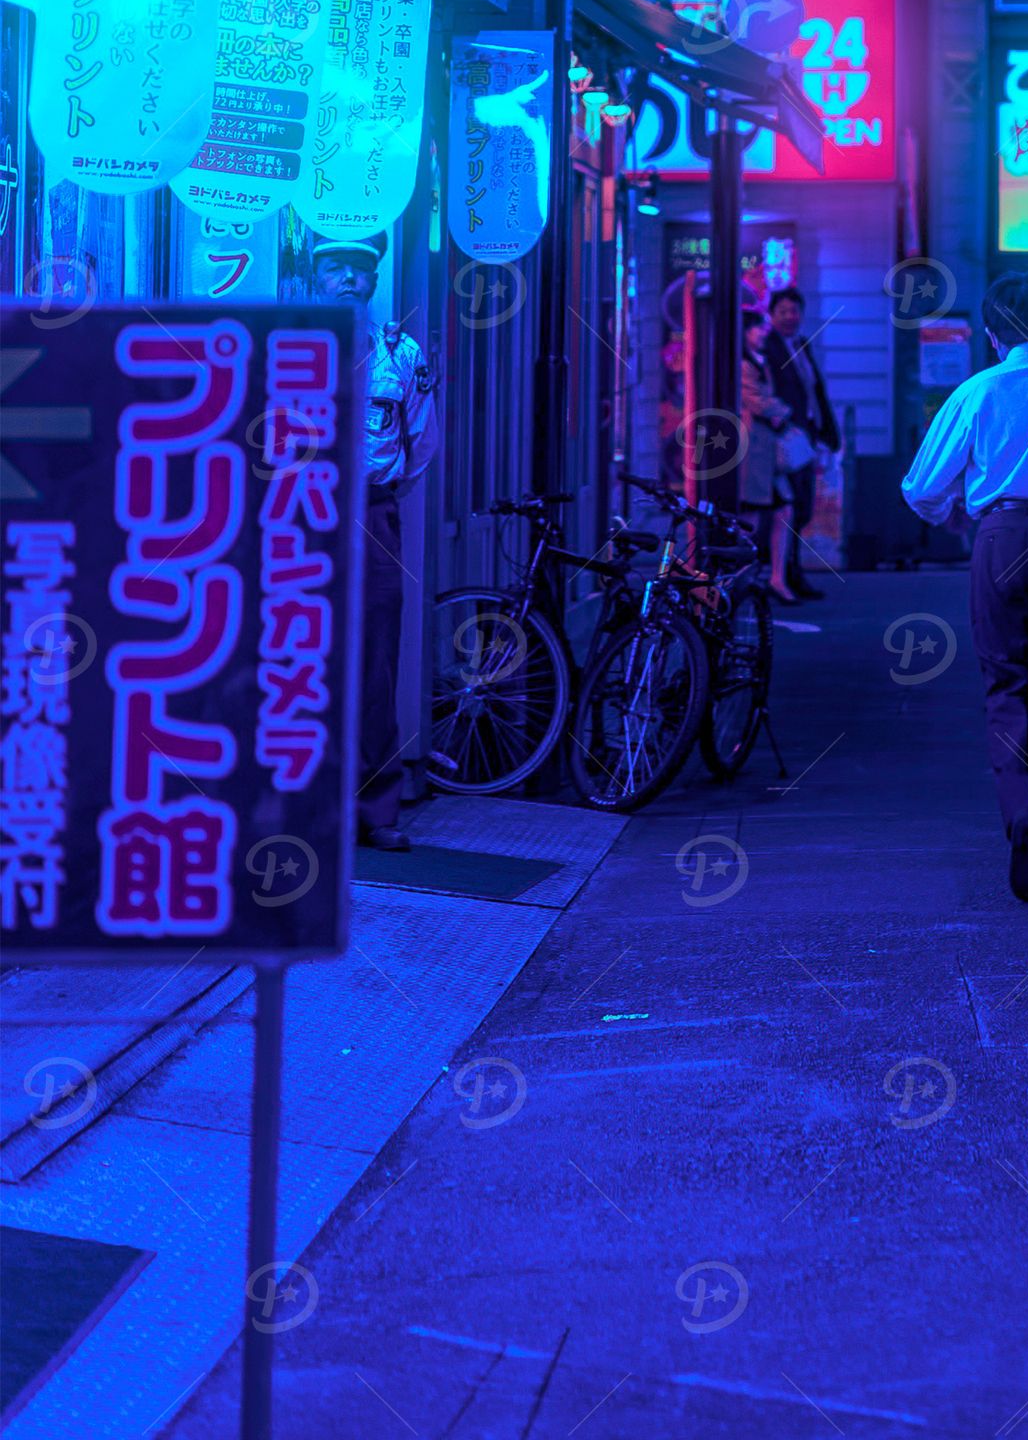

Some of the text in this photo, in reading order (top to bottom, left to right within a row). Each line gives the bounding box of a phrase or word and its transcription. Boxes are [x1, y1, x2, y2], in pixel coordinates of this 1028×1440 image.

[799, 16, 870, 69] 24
[821, 116, 883, 147] PEN
[97, 318, 251, 937] プリント館
[256, 328, 339, 792] ヨドバシカメラ
